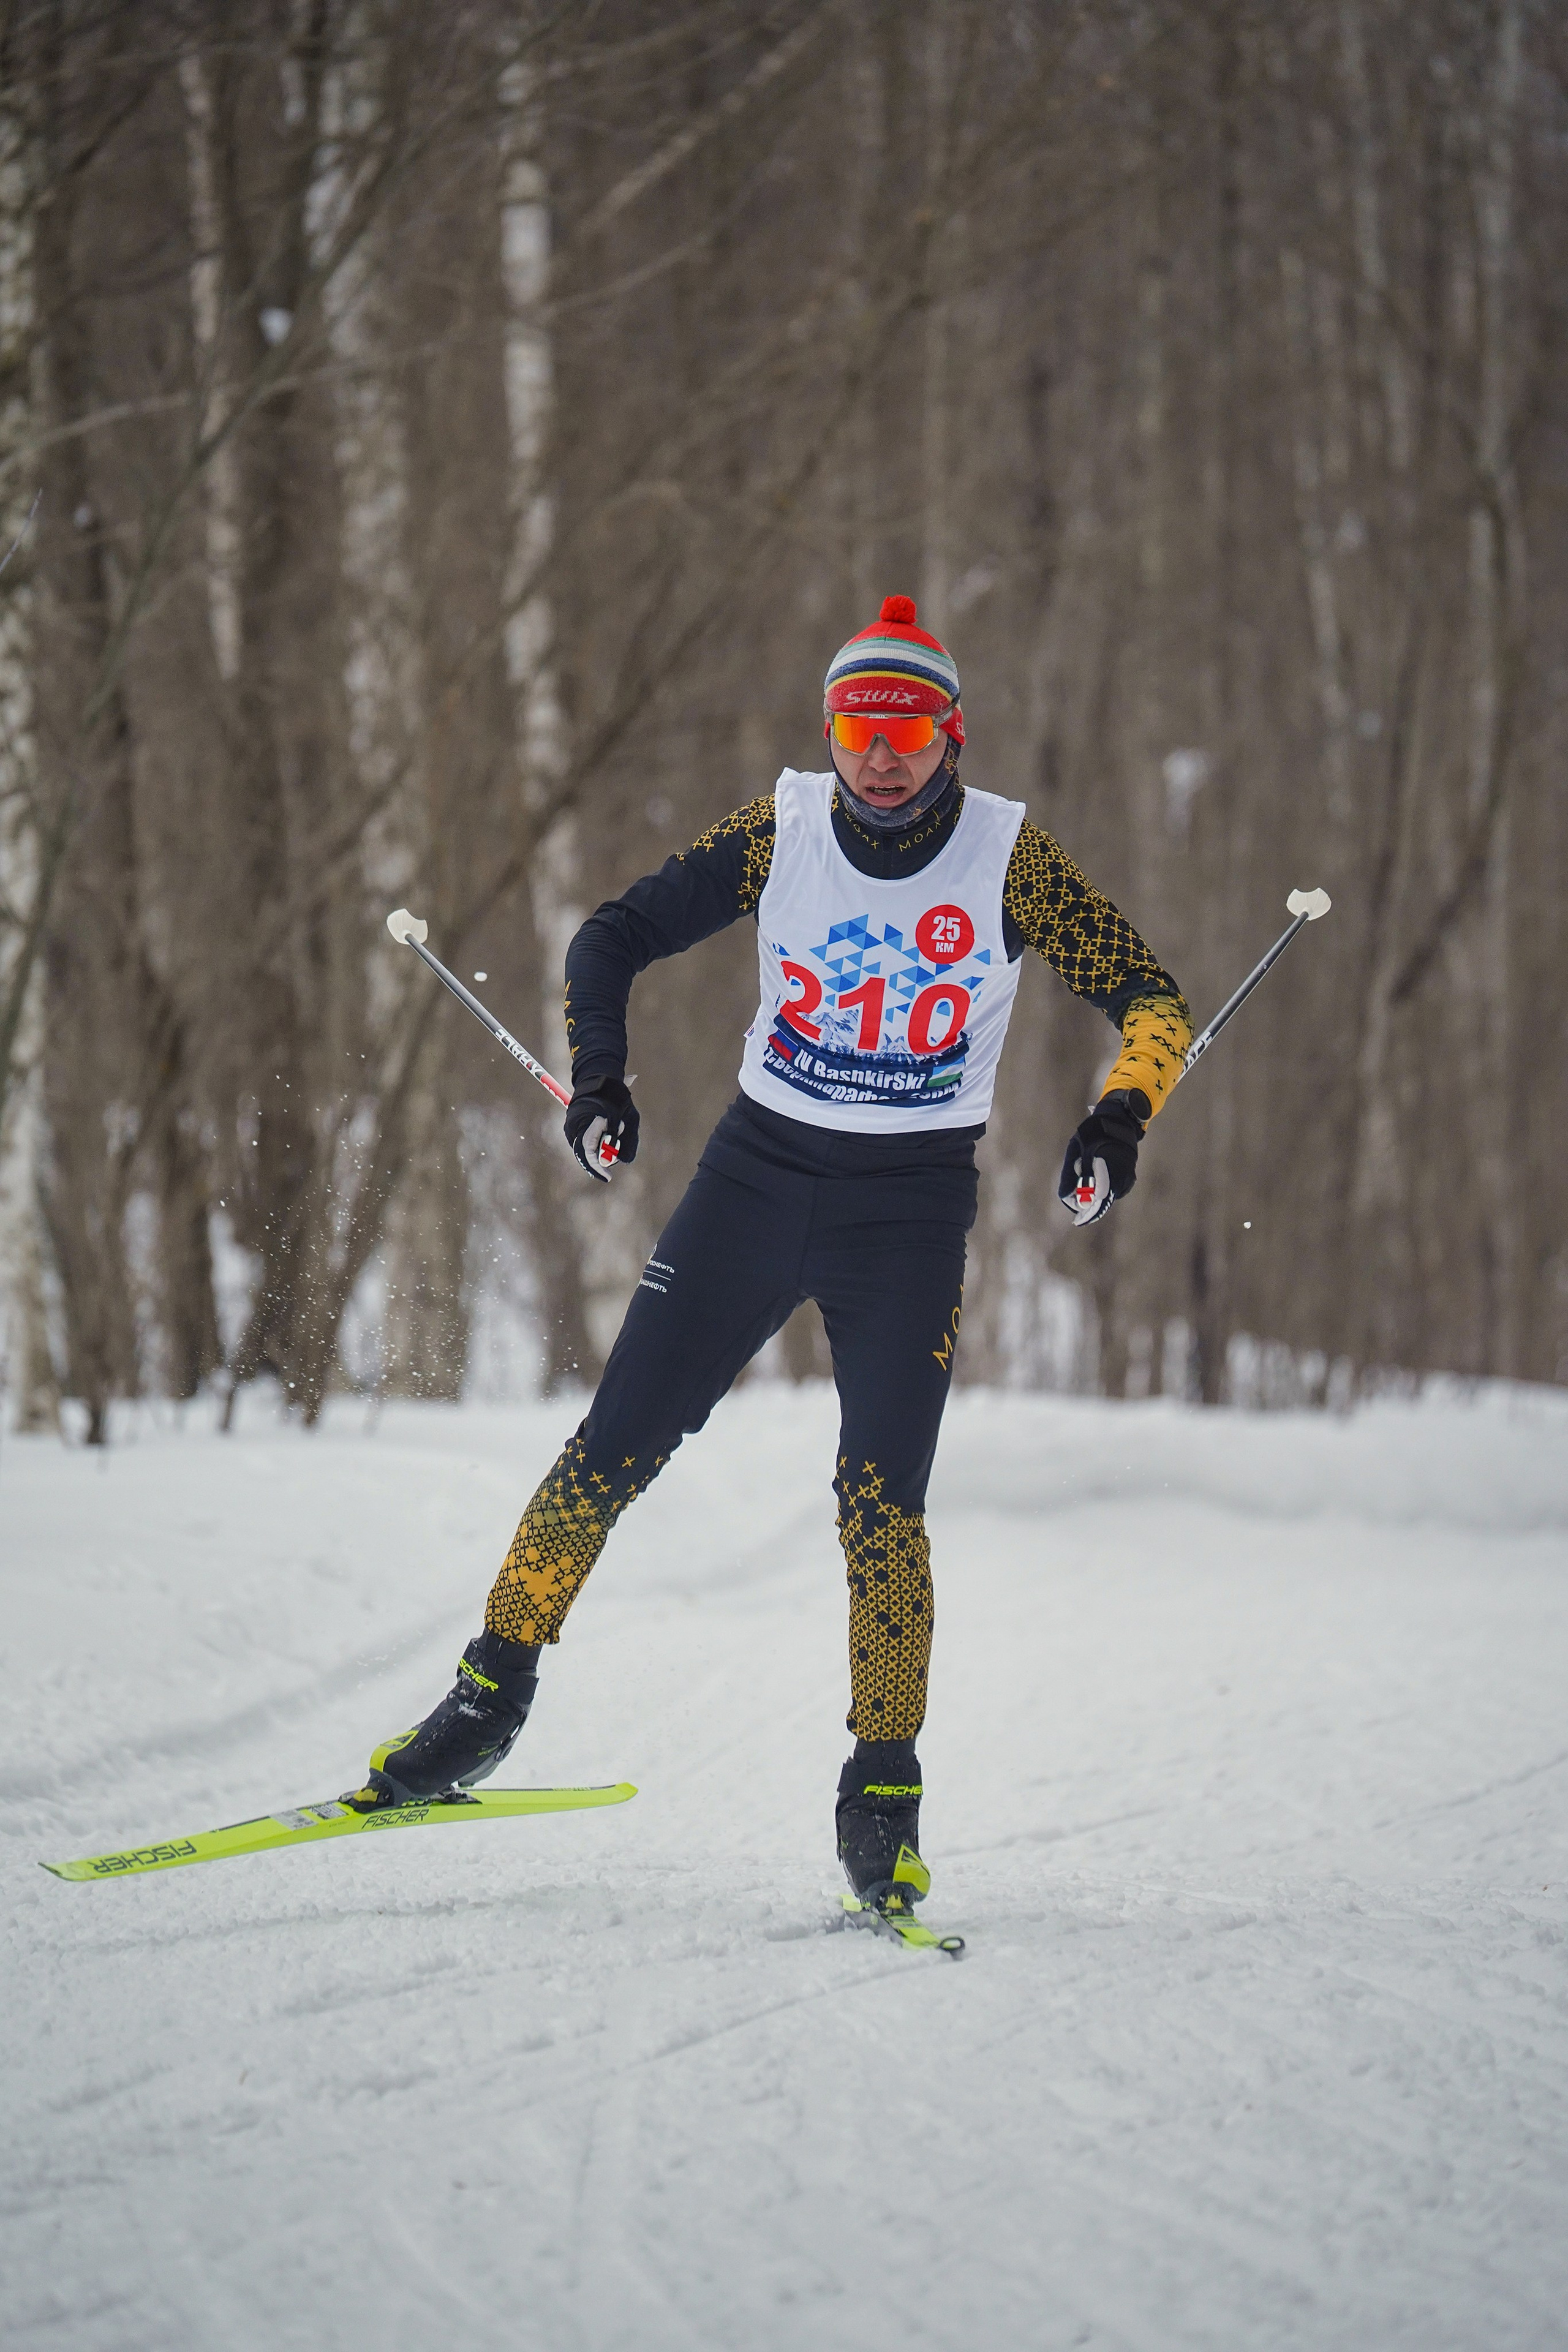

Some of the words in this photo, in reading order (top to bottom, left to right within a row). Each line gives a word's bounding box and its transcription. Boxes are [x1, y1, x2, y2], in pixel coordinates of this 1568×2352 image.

[899, 820, 941, 852] MOAX
[931, 915, 960, 941] 25
[780, 960, 971, 1054] 210
[794, 1049, 813, 1072] IV
[863, 1785, 923, 1796] FISCHE
[361, 1809, 429, 1829] FISCHER
[87, 1841, 197, 1874] FISCHER
